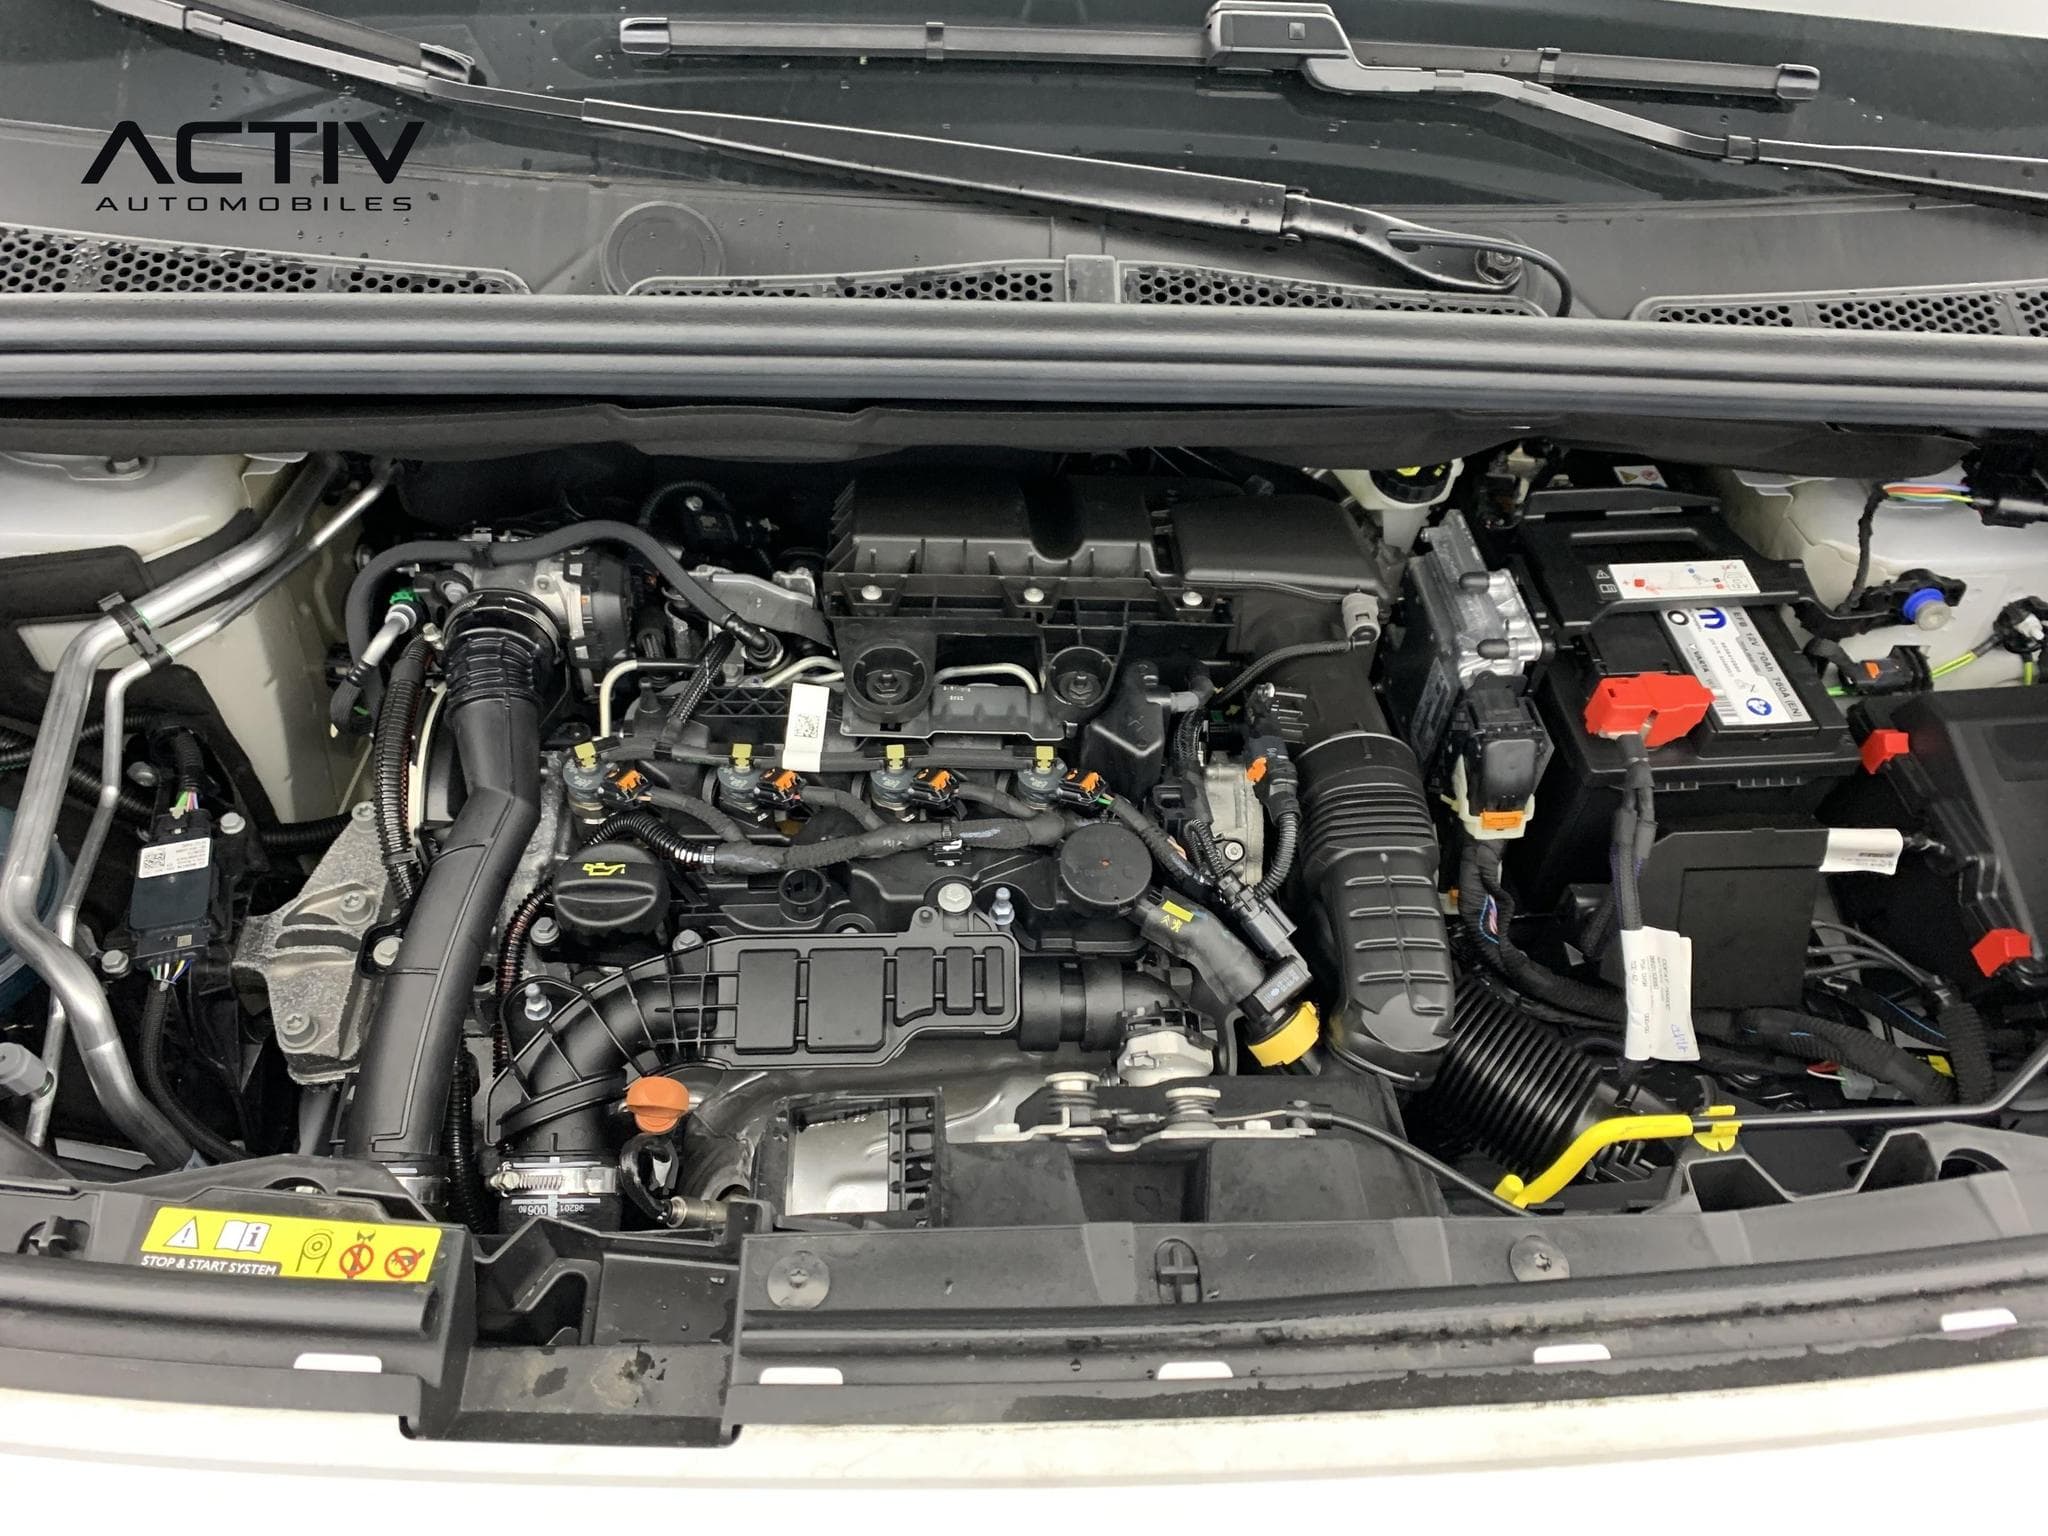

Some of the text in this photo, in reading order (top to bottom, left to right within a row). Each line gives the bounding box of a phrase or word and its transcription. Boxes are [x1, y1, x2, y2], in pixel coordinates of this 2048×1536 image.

[1693, 650, 1710, 673] VARTA
[1746, 632, 1760, 647] 12V
[1757, 651, 1775, 673] 70Ah
[1785, 699, 1803, 718] (EN)
[141, 1255, 277, 1275] STOP & START SYSTEM
